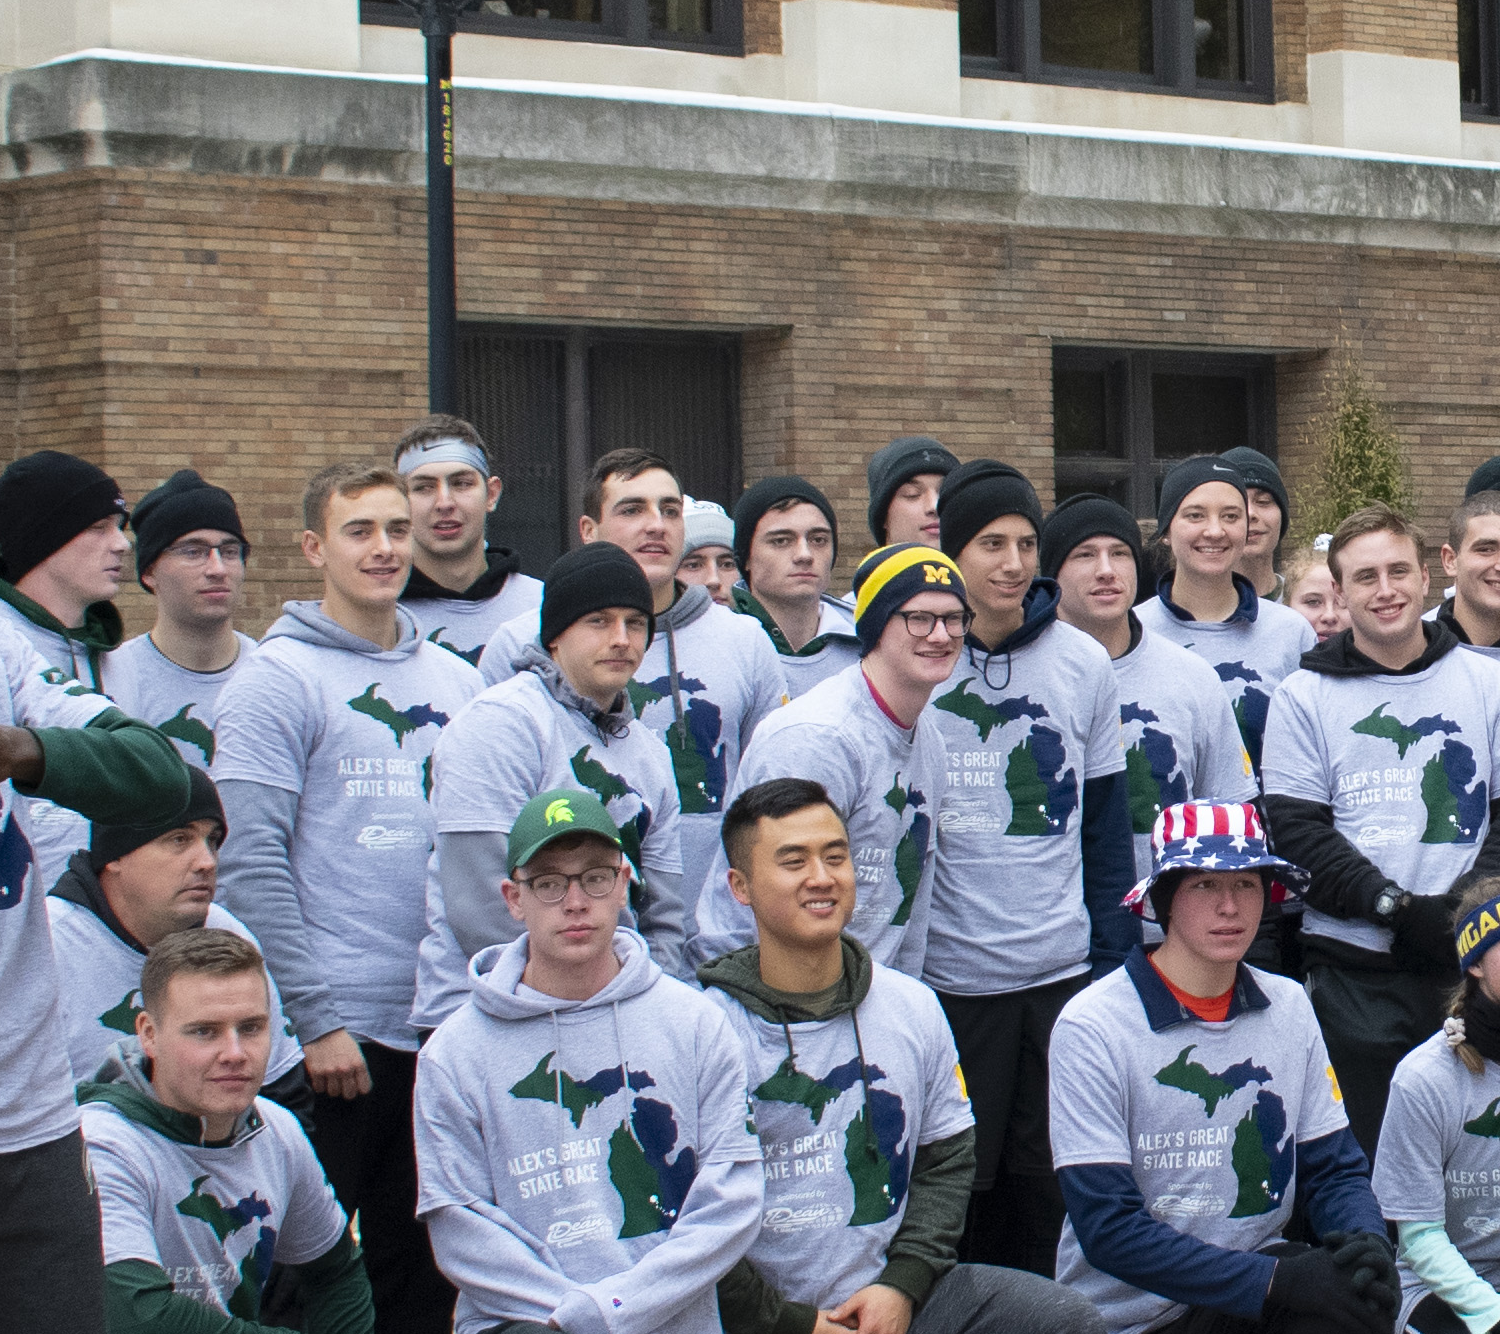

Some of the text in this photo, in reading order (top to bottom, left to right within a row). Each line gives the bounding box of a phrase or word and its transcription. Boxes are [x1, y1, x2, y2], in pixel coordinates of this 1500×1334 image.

[923, 564, 951, 585] M
[338, 758, 417, 776] ALEX'S GREAT
[963, 751, 1002, 767] GREAT
[345, 779, 417, 797] STATE RACE
[963, 771, 996, 787] RACE
[1338, 767, 1417, 790] ALEX'S GREAT
[1345, 786, 1414, 806] STATE RACE
[794, 1130, 837, 1155] GREAT
[1137, 1126, 1229, 1151] ALEX'S GREAT
[508, 1137, 602, 1177] ALEX'S GREAT
[765, 1154, 835, 1180] ATE RACE
[1143, 1150, 1223, 1170] STATE RACE
[520, 1163, 599, 1199] STATE RACE
[1445, 1169, 1488, 1184] ALEX'S
[1452, 1186, 1489, 1199] STATE
